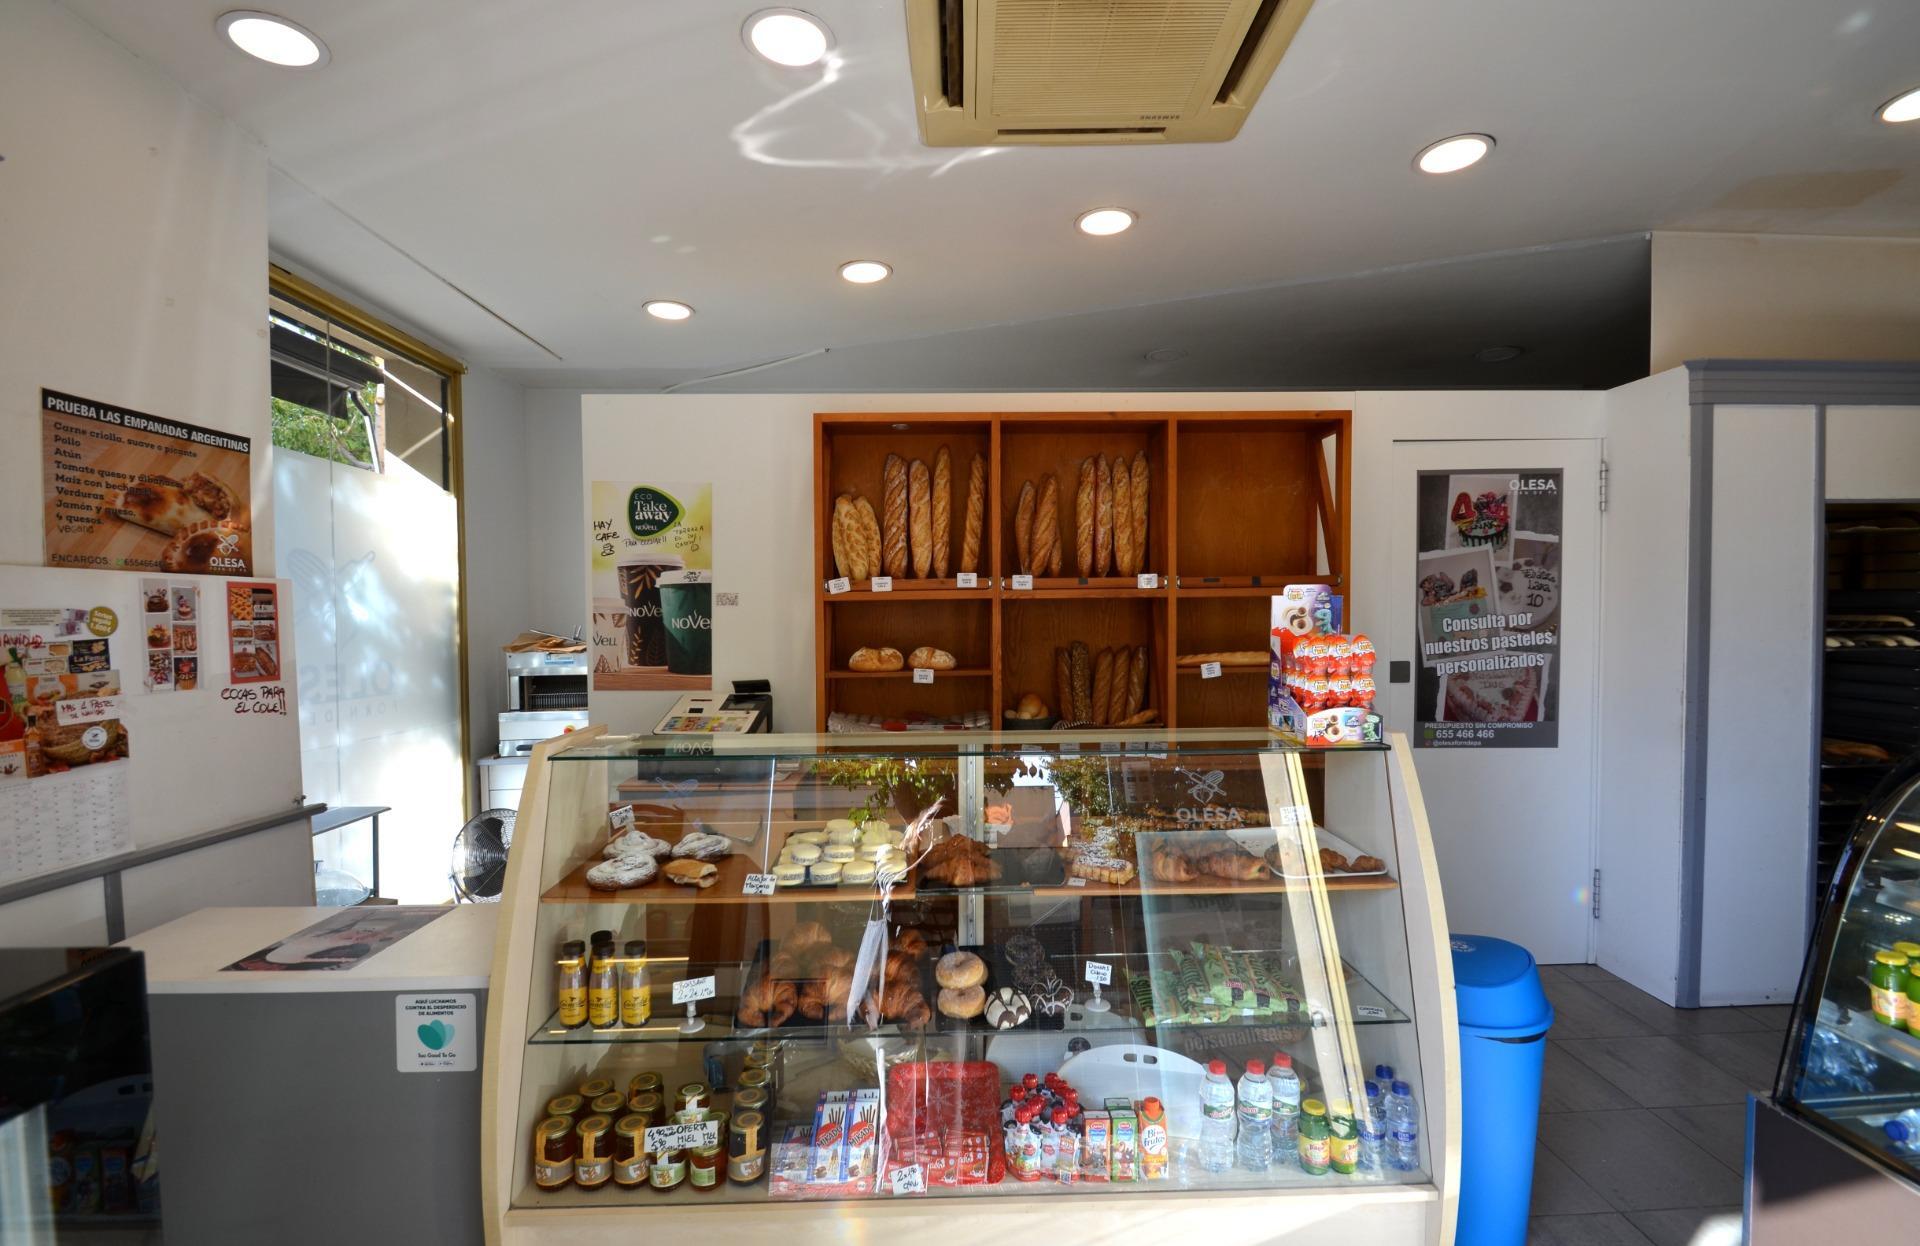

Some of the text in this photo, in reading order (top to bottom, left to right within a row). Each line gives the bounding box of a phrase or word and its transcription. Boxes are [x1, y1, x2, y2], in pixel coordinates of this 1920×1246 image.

[47, 396, 249, 452] PRUEBA LAS EMPANADAS ARGENTINAS
[54, 422, 88, 435] Carne
[127, 438, 156, 450] suave
[164, 445, 197, 458] picante
[54, 434, 81, 447] Pollo
[54, 447, 82, 459] Atún
[54, 460, 96, 474] Tomate
[98, 469, 127, 479] queso
[84, 478, 103, 488] con
[1509, 479, 1557, 490] OLESA
[55, 486, 105, 500] Verduras
[56, 499, 93, 511] Jamón
[95, 505, 102, 514] y
[634, 500, 667, 512] Take
[56, 512, 62, 520] 4
[634, 511, 672, 523] away
[593, 518, 613, 530] HAY
[51, 553, 112, 565] ENCARGOS:
[209, 557, 246, 568] OLESA
[1526, 593, 1544, 608] 10
[1442, 612, 1533, 633] Consulta por
[1425, 630, 1553, 656] nuestros pasteles
[1436, 653, 1545, 677] personalizados
[220, 686, 286, 701] COCAS PARA
[234, 701, 251, 714] EL
[1436, 729, 1495, 738] 655 466 466
[1176, 807, 1242, 821] OLESA
[676, 1122, 708, 1134] OFERTA
[847, 1122, 875, 1147] MIKADO
[1147, 1127, 1157, 1139] Bi
[677, 1134, 697, 1143] MIEL
[816, 1124, 843, 1148] MIKADO
[1143, 1136, 1166, 1147] frutas
